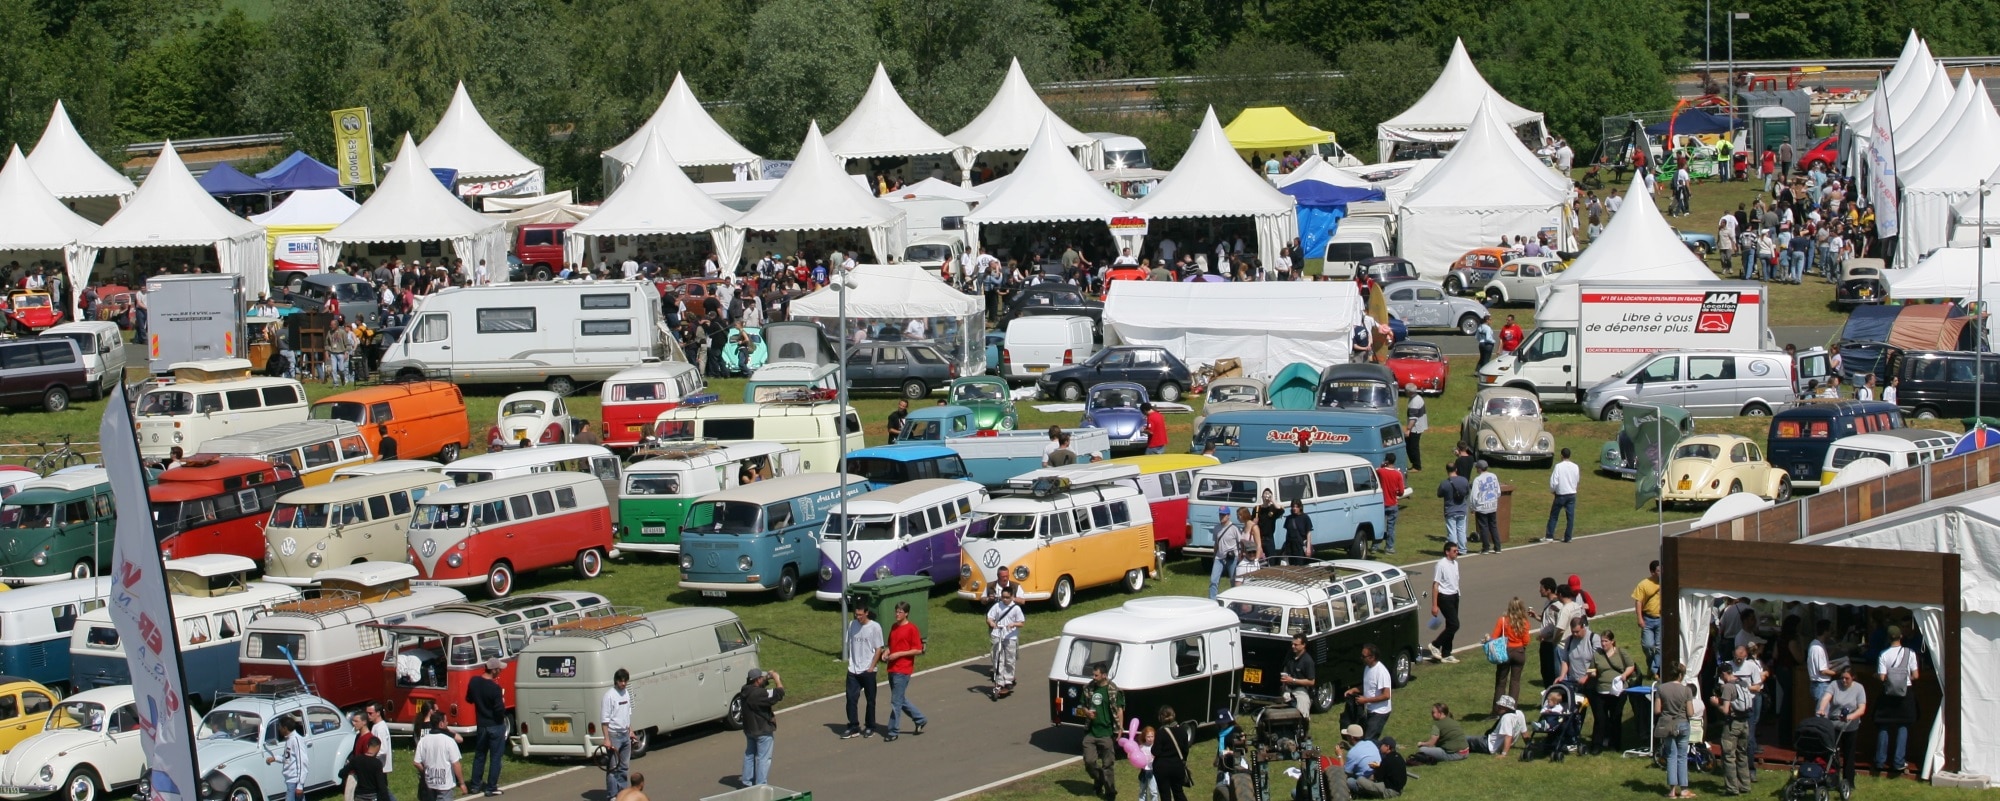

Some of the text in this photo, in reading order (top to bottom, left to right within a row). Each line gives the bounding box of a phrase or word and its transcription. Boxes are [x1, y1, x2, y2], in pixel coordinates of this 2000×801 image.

[490, 180, 514, 191] COX
[1704, 293, 1738, 304] ADA
[1622, 312, 1693, 323] Libre à vous
[1585, 322, 1691, 334] de dépenser plus.
[1267, 430, 1351, 442] Arte Diem
[422, 538, 437, 558] VW
[983, 548, 1001, 569] VW
